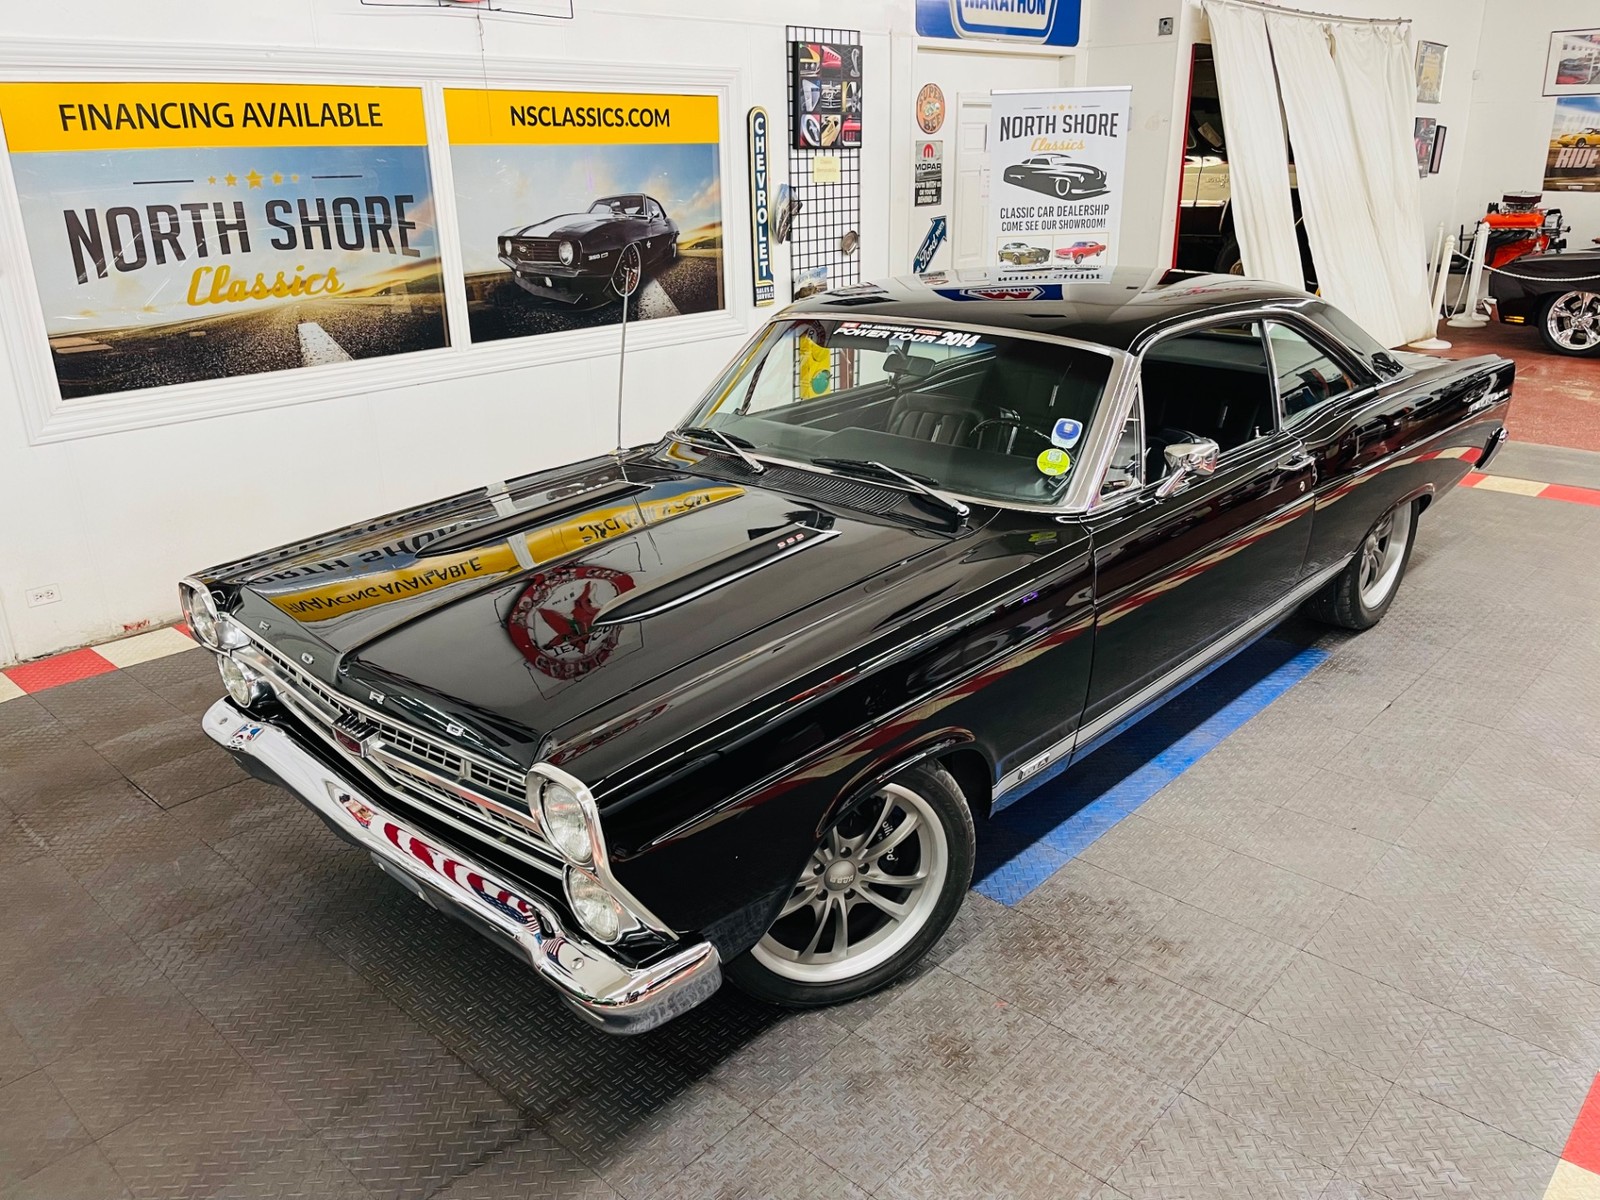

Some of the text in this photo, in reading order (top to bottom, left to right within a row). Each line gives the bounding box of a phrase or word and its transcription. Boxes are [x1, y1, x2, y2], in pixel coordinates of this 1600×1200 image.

[58, 102, 383, 131] FINANCING AVAILABLE
[510, 105, 671, 127] NSCLASSICS.COM
[923, 114, 942, 131] BEE
[1000, 113, 1119, 142] NORTH SHORE
[1031, 137, 1085, 152] Classics
[915, 163, 941, 171] MOPAR
[1554, 147, 1600, 169] RIDE
[754, 117, 768, 277] CHEVROLET
[1000, 204, 1110, 219] CLASSIC CAR DEALERSHIP
[1001, 218, 1106, 231] COME SEE OUR SHOWROOM!
[63, 194, 421, 285] NORTH SHORE
[187, 265, 345, 307] Classics
[833, 327, 891, 339] POWER
[891, 332, 938, 343] TOUR
[936, 331, 981, 348] 2014
